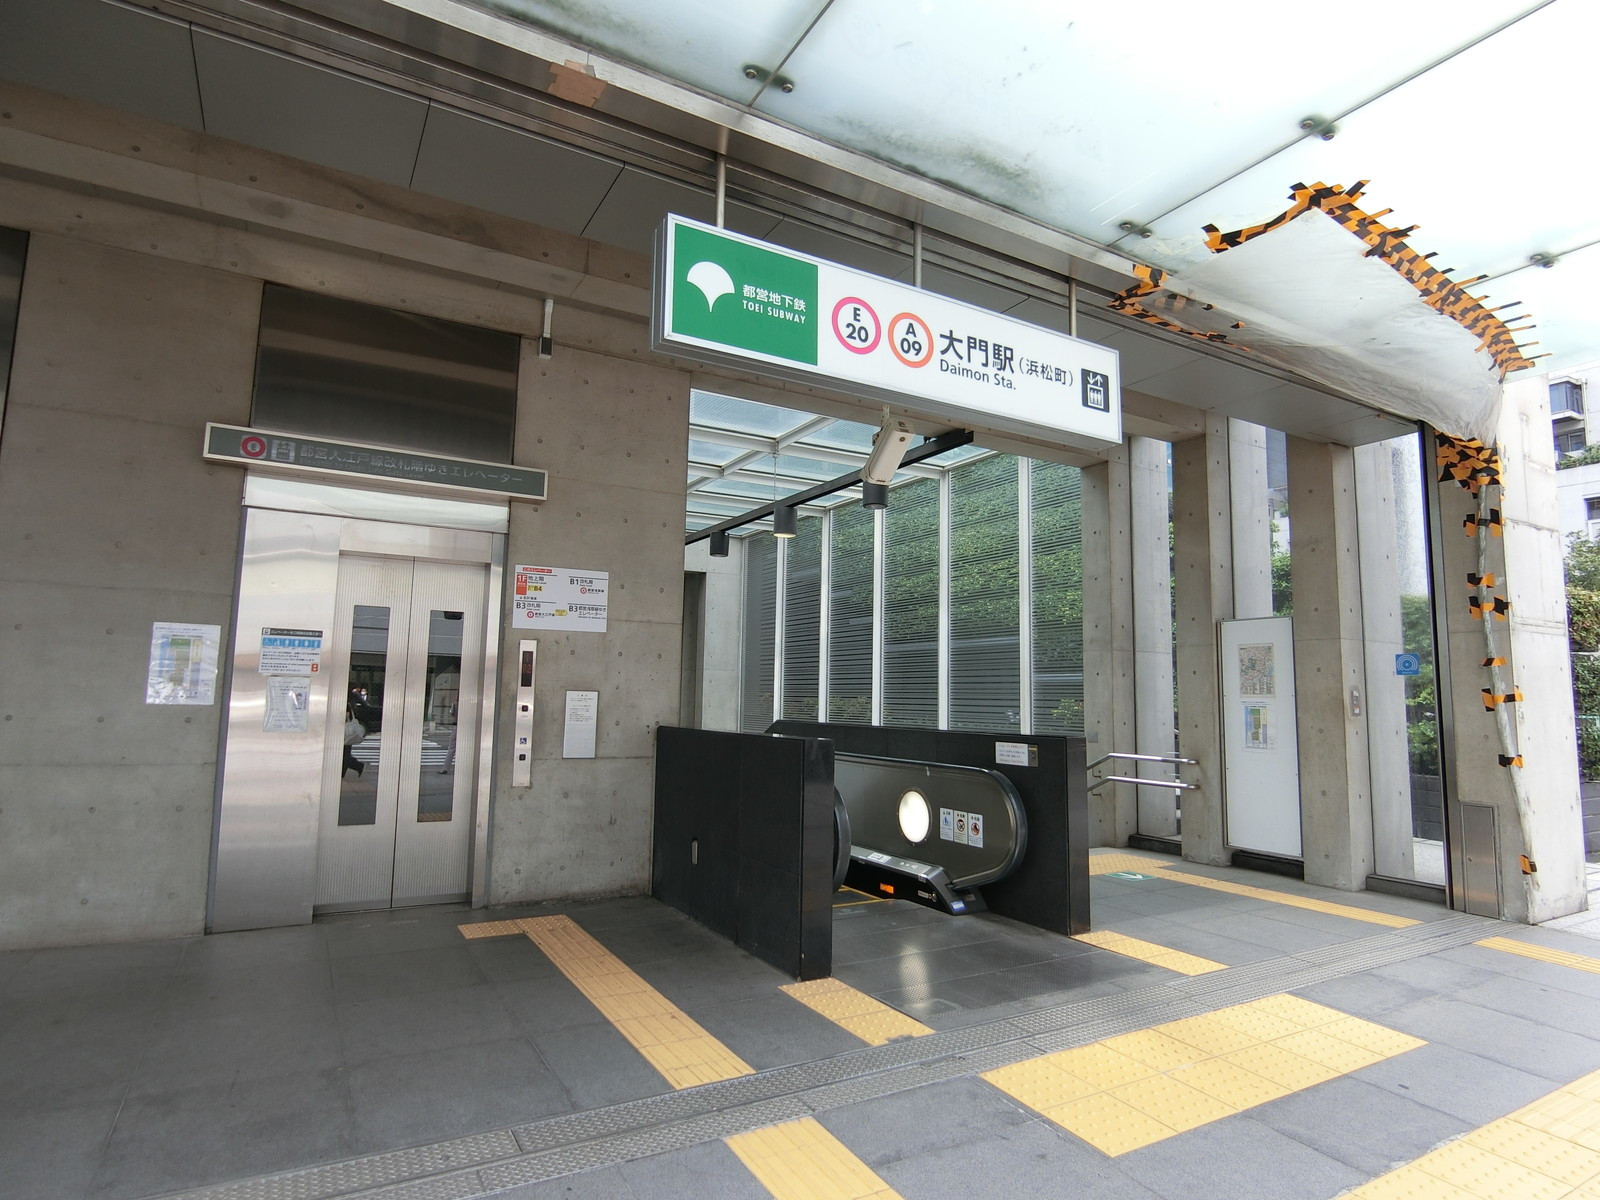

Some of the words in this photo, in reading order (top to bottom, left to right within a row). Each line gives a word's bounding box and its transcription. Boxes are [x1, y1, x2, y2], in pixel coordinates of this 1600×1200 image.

[742, 283, 807, 313] 都営地下鉄
[742, 301, 764, 315] TOEI
[767, 306, 807, 325] SUBWAY
[853, 307, 861, 321] E
[846, 323, 869, 344] 20
[905, 323, 917, 337] A
[900, 337, 922, 357] 09
[939, 330, 1015, 375] 大門駅
[940, 359, 989, 384] Daimon
[994, 373, 1016, 391] Sta.
[517, 574, 527, 582] 1F
